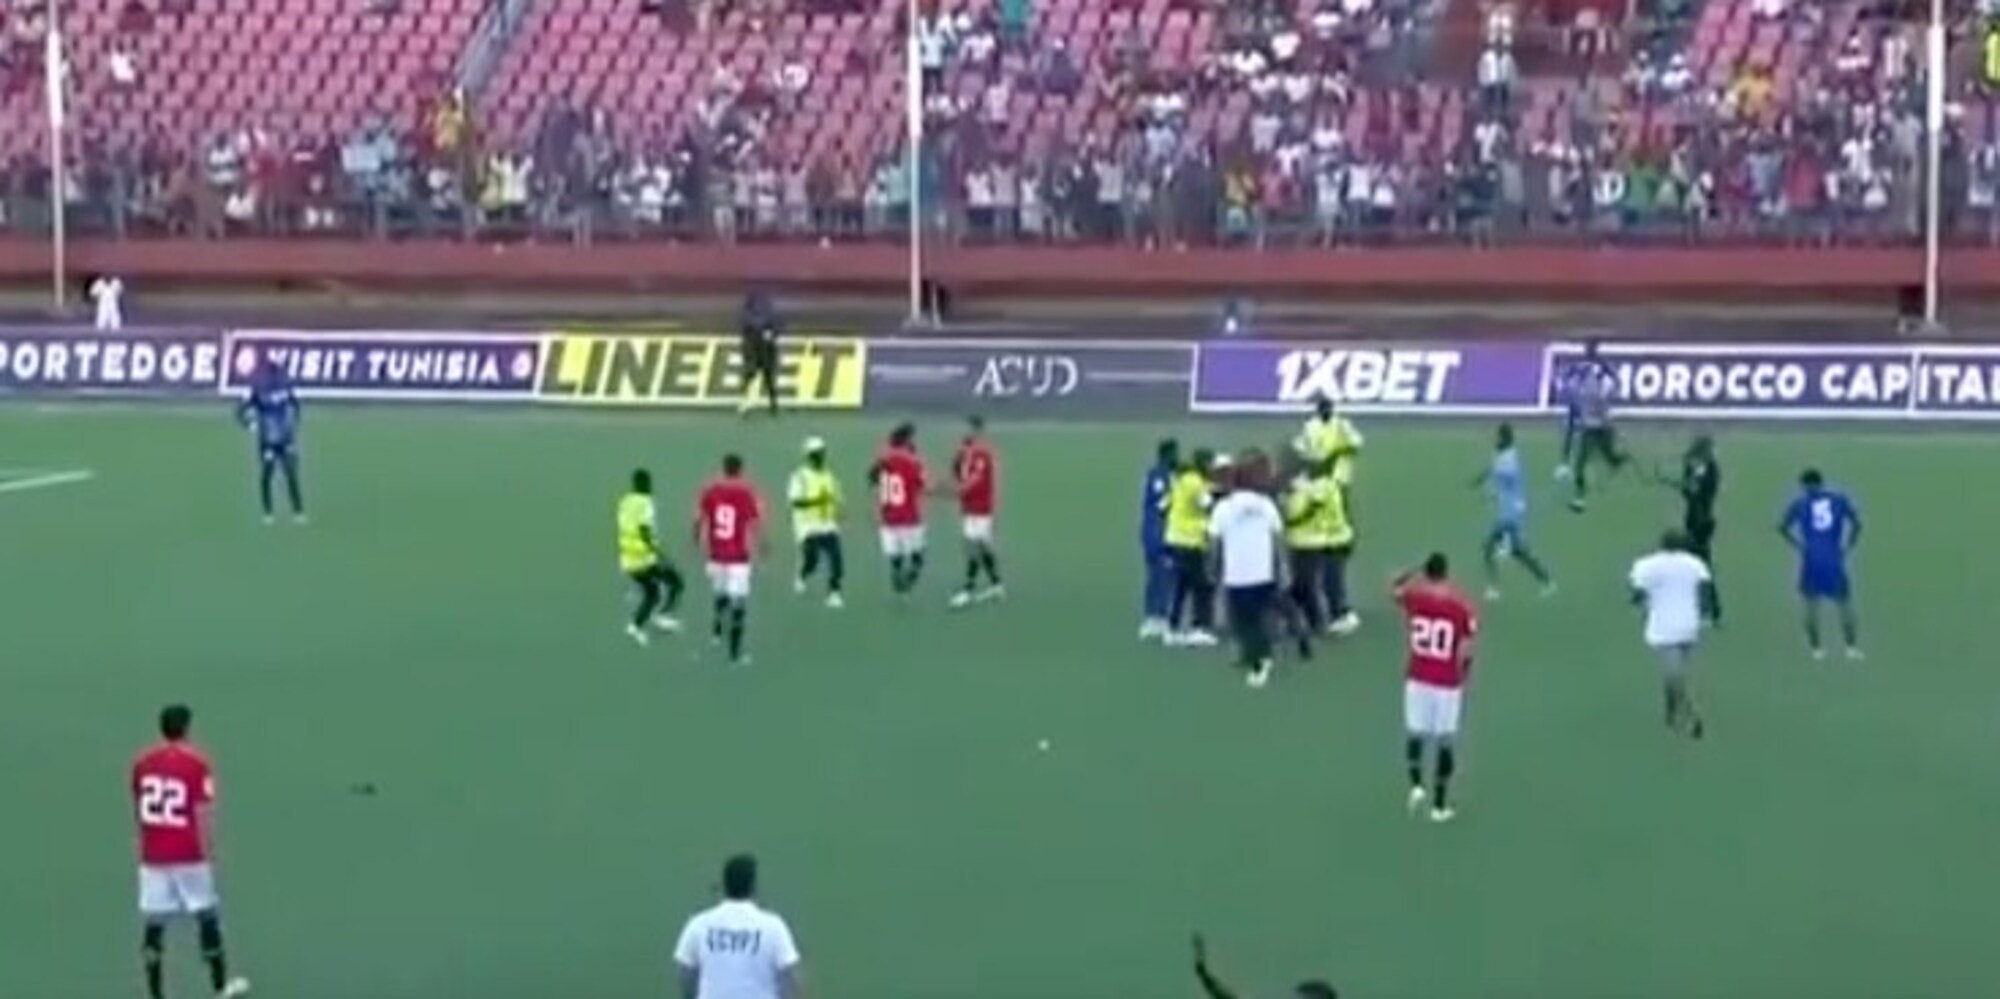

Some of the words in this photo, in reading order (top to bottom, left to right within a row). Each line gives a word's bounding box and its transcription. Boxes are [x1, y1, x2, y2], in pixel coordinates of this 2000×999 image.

[368, 351, 499, 380] TUNISIA
[540, 340, 855, 398] LINEBET
[1276, 351, 1460, 402] 1XBET
[715, 504, 736, 539] 9
[1811, 500, 1833, 531] 5
[1410, 616, 1454, 658] 20
[140, 774, 189, 828] 22
